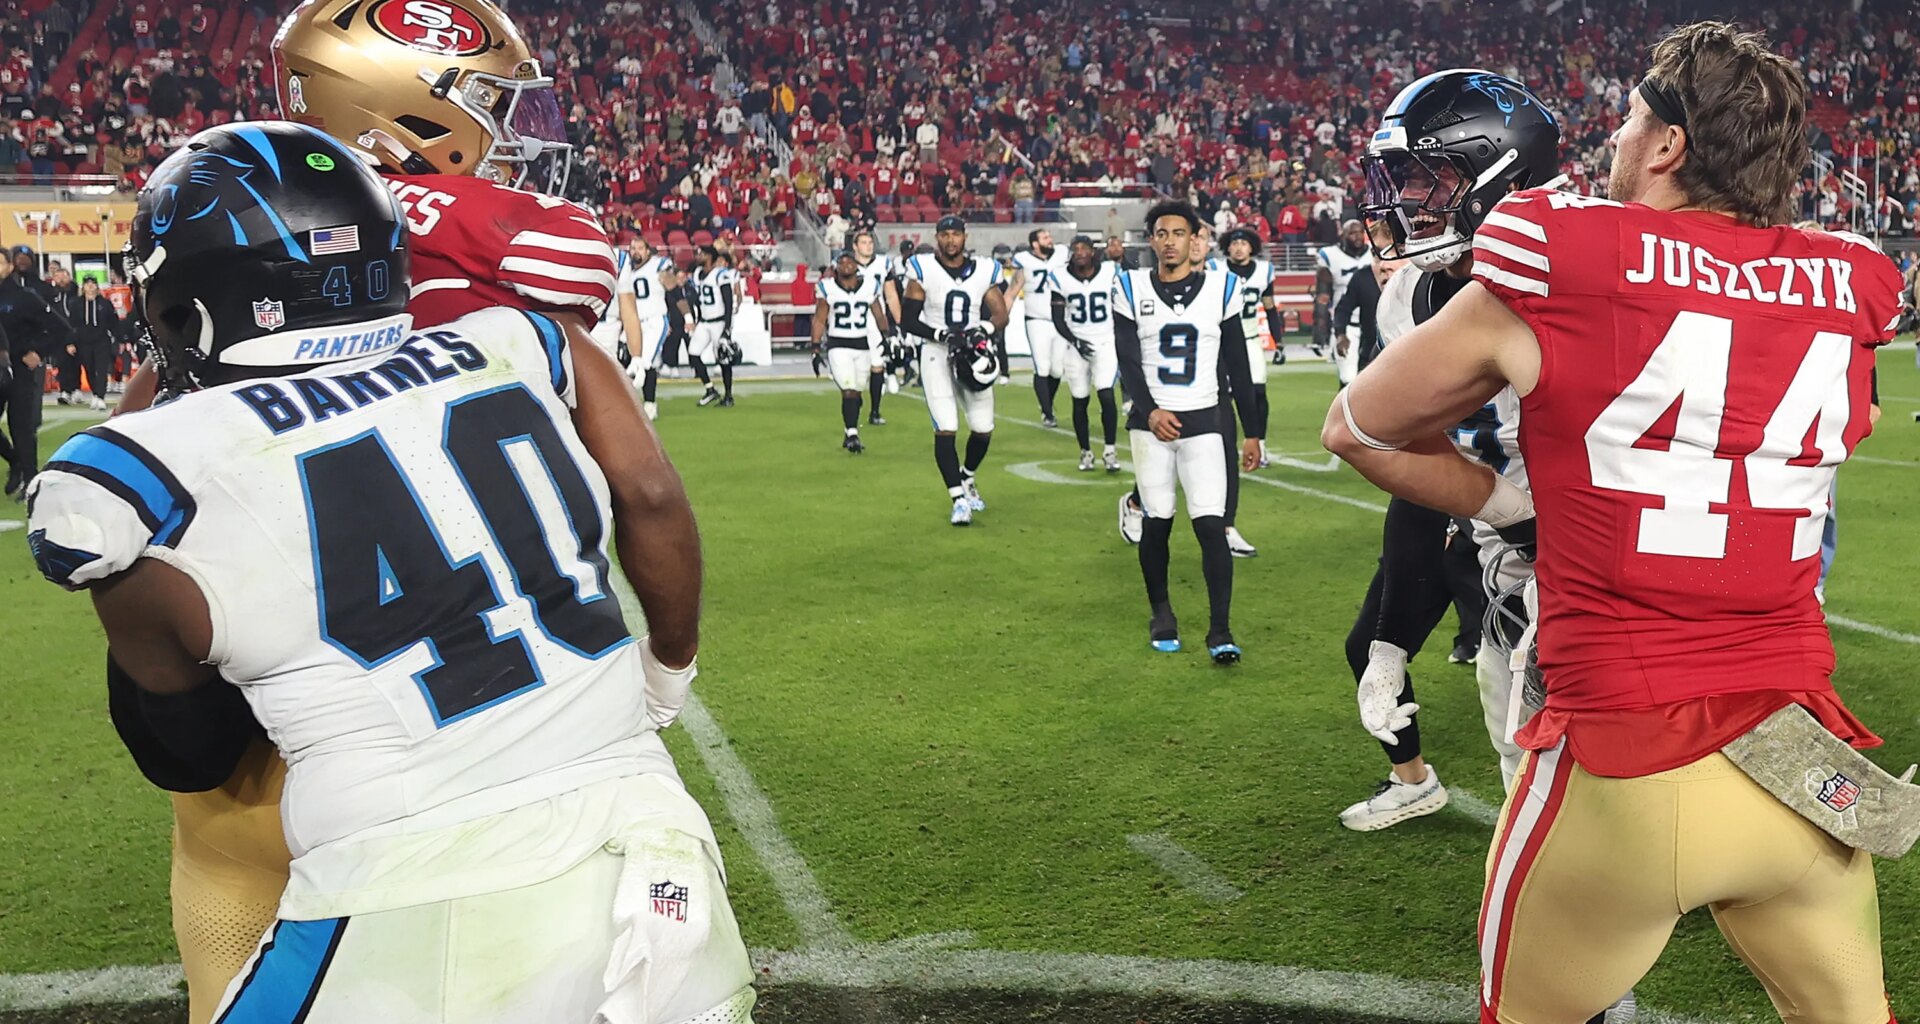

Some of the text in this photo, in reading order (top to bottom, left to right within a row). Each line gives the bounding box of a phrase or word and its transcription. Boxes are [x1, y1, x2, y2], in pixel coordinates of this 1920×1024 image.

[403, 1, 473, 48] SF
[26, 221, 101, 236] SAN
[322, 259, 390, 306] 40
[1625, 232, 1857, 314] JUSZCZYK
[697, 284, 715, 305] 9
[944, 289, 971, 331] 0
[1067, 291, 1108, 323] 36
[259, 313, 282, 325] NFL
[833, 301, 869, 329] 23
[294, 323, 404, 361] PANTHERS
[1158, 323, 1199, 386] 9
[230, 331, 489, 436] BARNES
[1584, 310, 1853, 562] 44
[294, 381, 638, 730] 40
[1829, 784, 1859, 809] NFL
[653, 899, 684, 921] NFL
